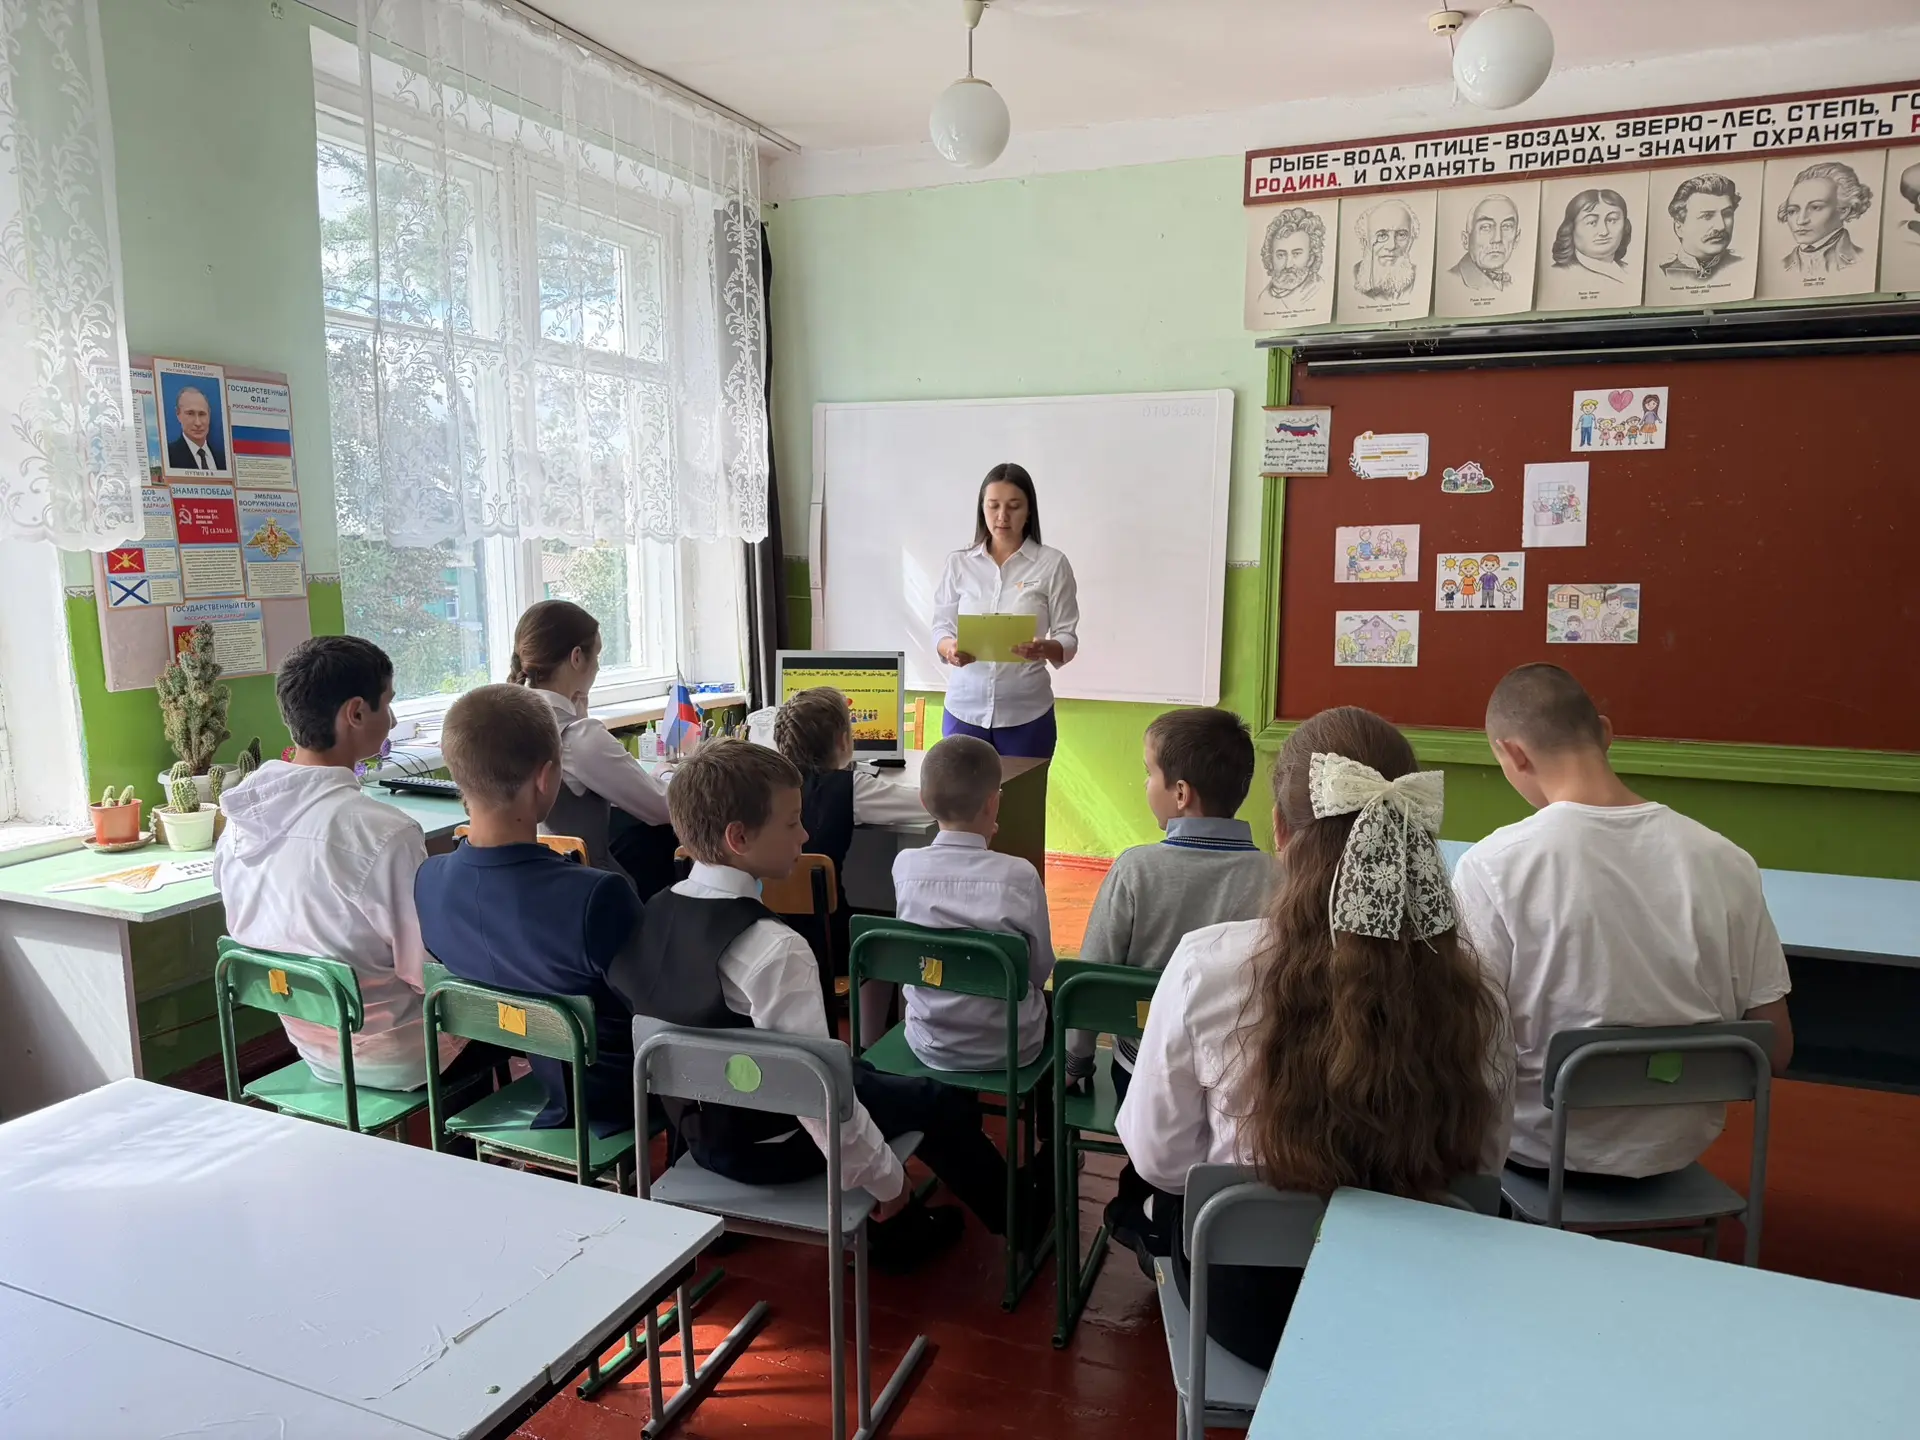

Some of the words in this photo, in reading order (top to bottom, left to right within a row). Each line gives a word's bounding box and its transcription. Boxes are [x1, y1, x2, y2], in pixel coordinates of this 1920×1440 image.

[1788, 99, 1879, 122] СТЕПЬ,
[1354, 169, 1367, 184] И
[1380, 157, 1495, 182] ОХРАНЯТЬ
[1753, 119, 1893, 147] ОХРАНЯТЬ
[228, 384, 287, 397] ГОСУДАРСТВЕННЫЙ
[250, 396, 269, 404] ФЛАГ
[172, 486, 199, 495] ЗНАМЯ
[201, 487, 232, 496] ПОБЕДЫ
[172, 602, 239, 612] ГОСУДАРСТВЕННЫЙ
[240, 601, 256, 609] ГЕРБ
